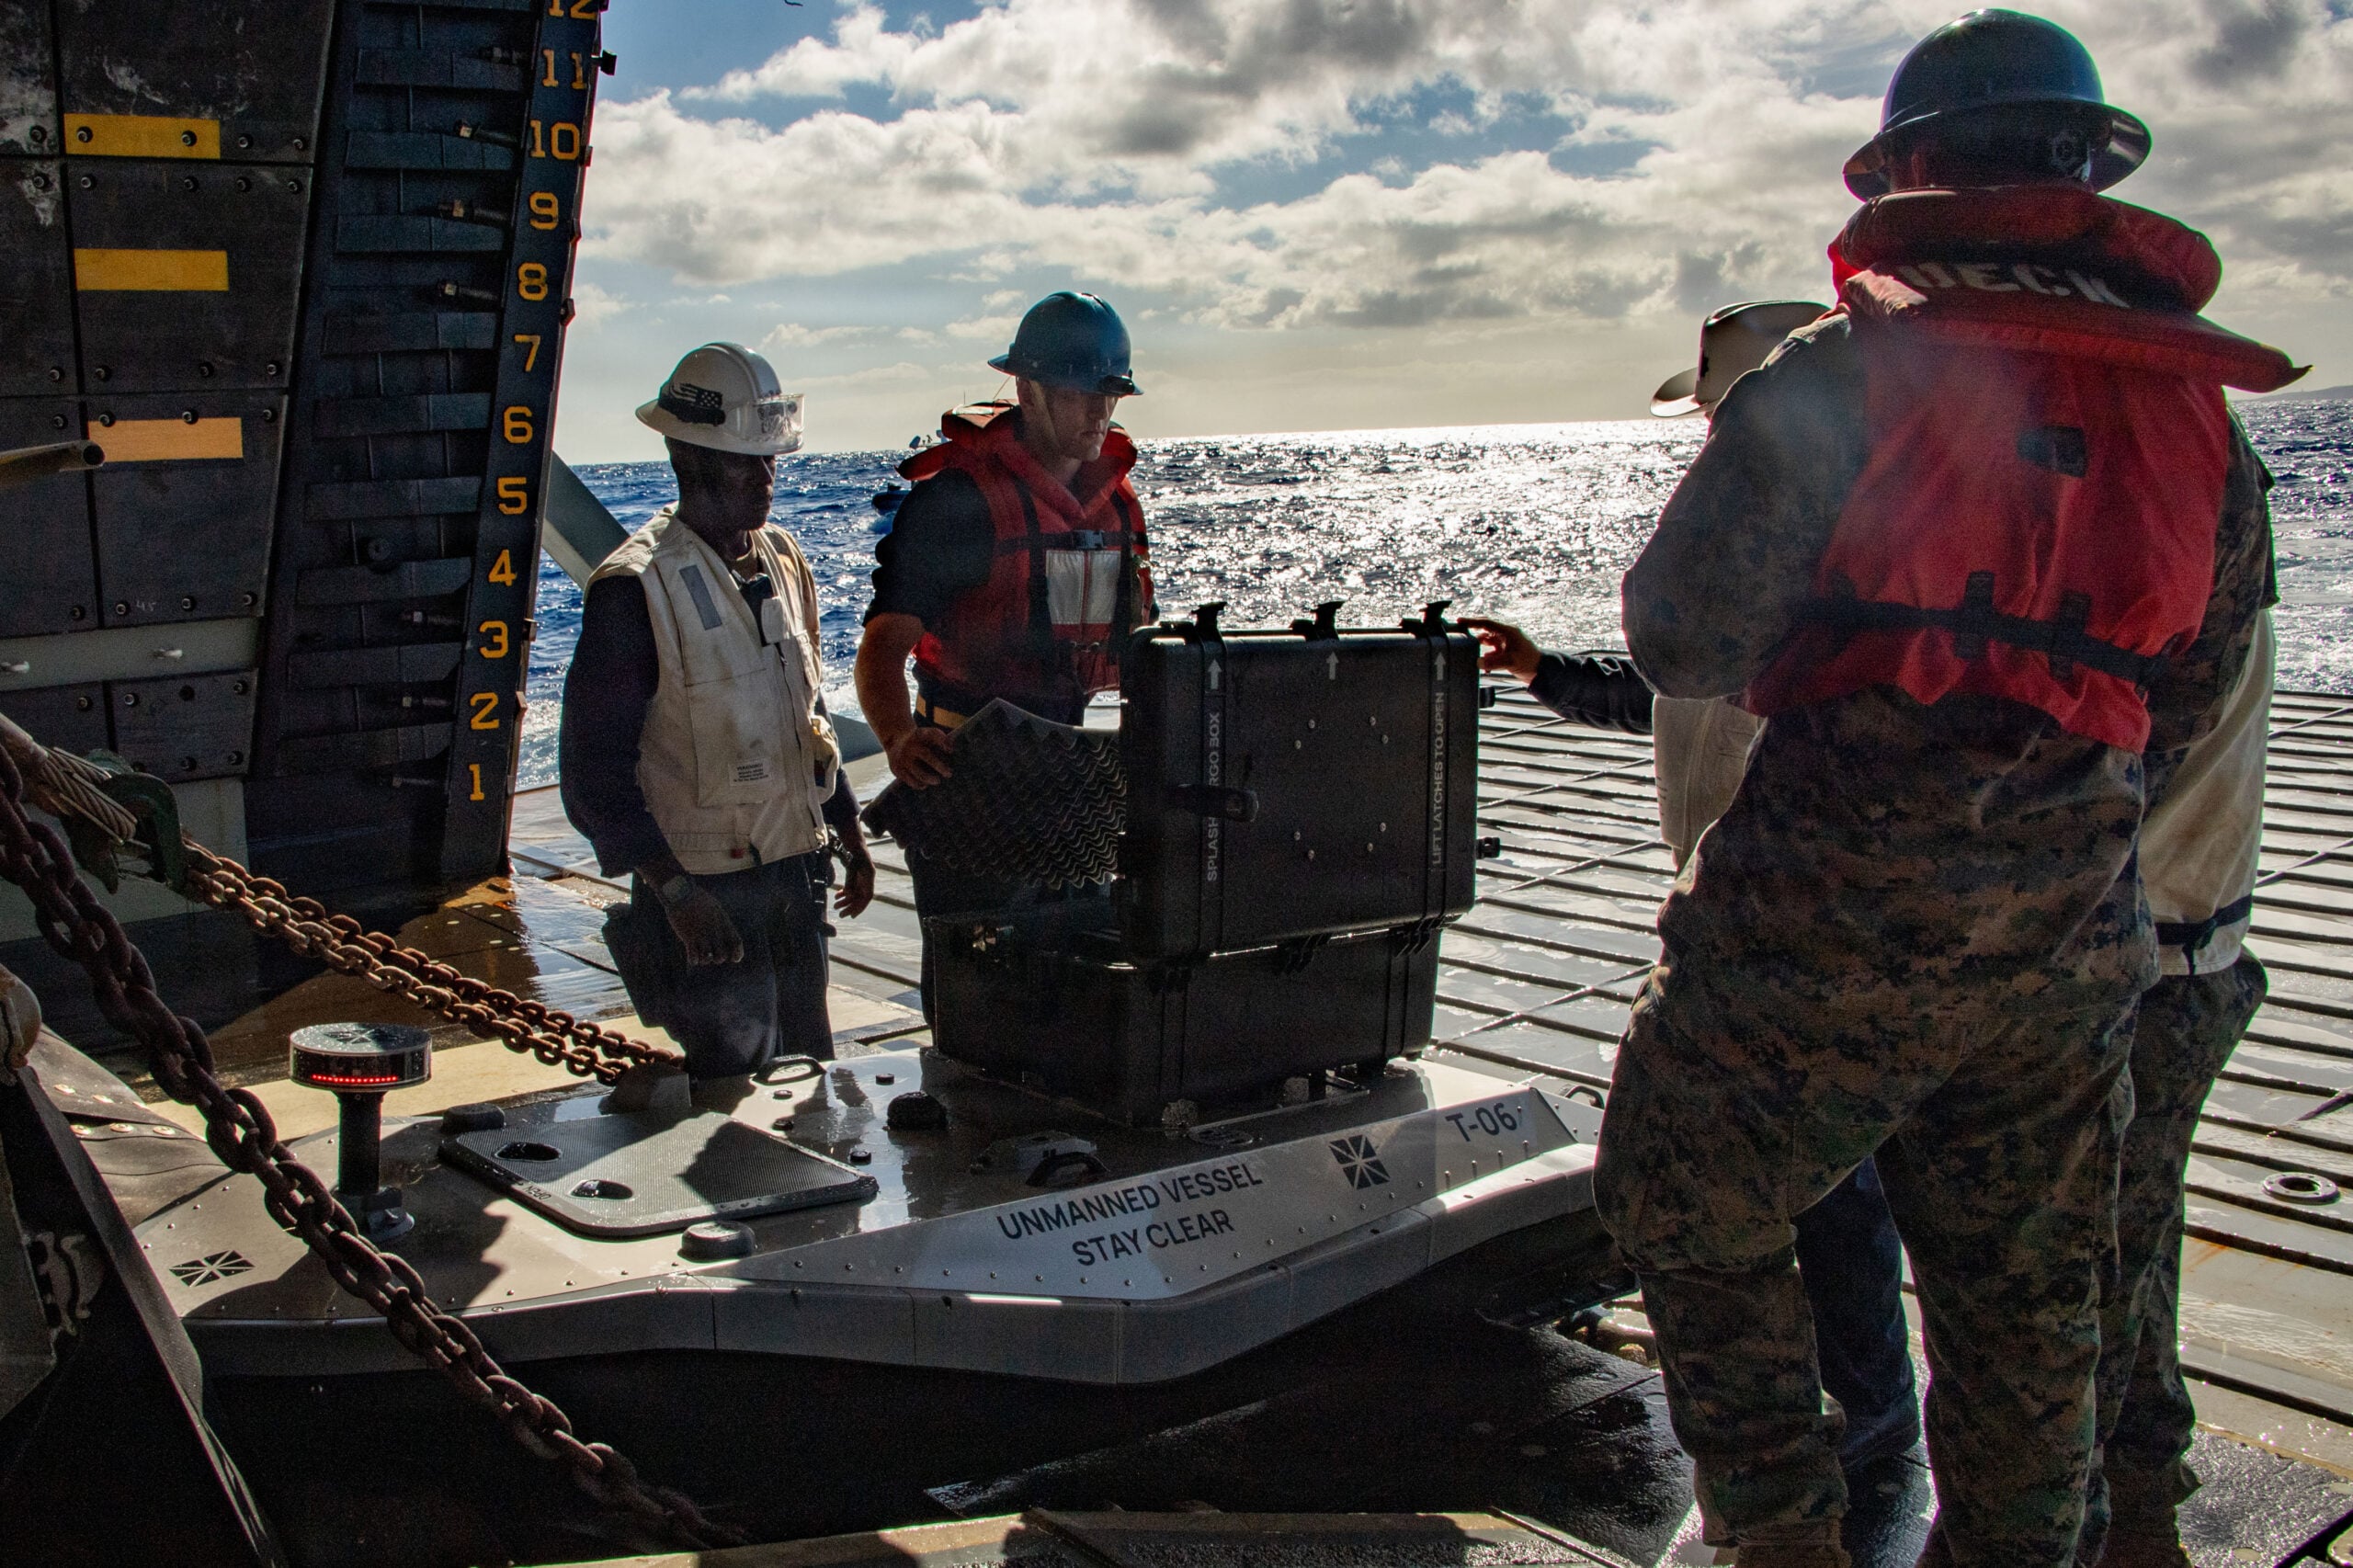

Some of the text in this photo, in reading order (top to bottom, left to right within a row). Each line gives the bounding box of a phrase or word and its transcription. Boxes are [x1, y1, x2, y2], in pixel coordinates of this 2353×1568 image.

[541, 49, 586, 90] 11
[529, 119, 581, 160] 10
[529, 191, 559, 230] 9
[517, 262, 549, 301] 8
[514, 334, 540, 372] 7
[503, 406, 533, 444] 6
[497, 476, 528, 515] 5
[488, 549, 517, 587] 4
[479, 620, 509, 659] 3
[470, 692, 500, 731] 2
[469, 764, 485, 801] 1
[1207, 711, 1221, 882] SPLASH RGO BOX
[1432, 692, 1446, 865] LIFT LATCHES TO OPEN
[1445, 1102, 1518, 1142] T-06
[996, 1164, 1263, 1240] UNMANNED VESSEL
[1072, 1209, 1234, 1267] STAY CLEAR
